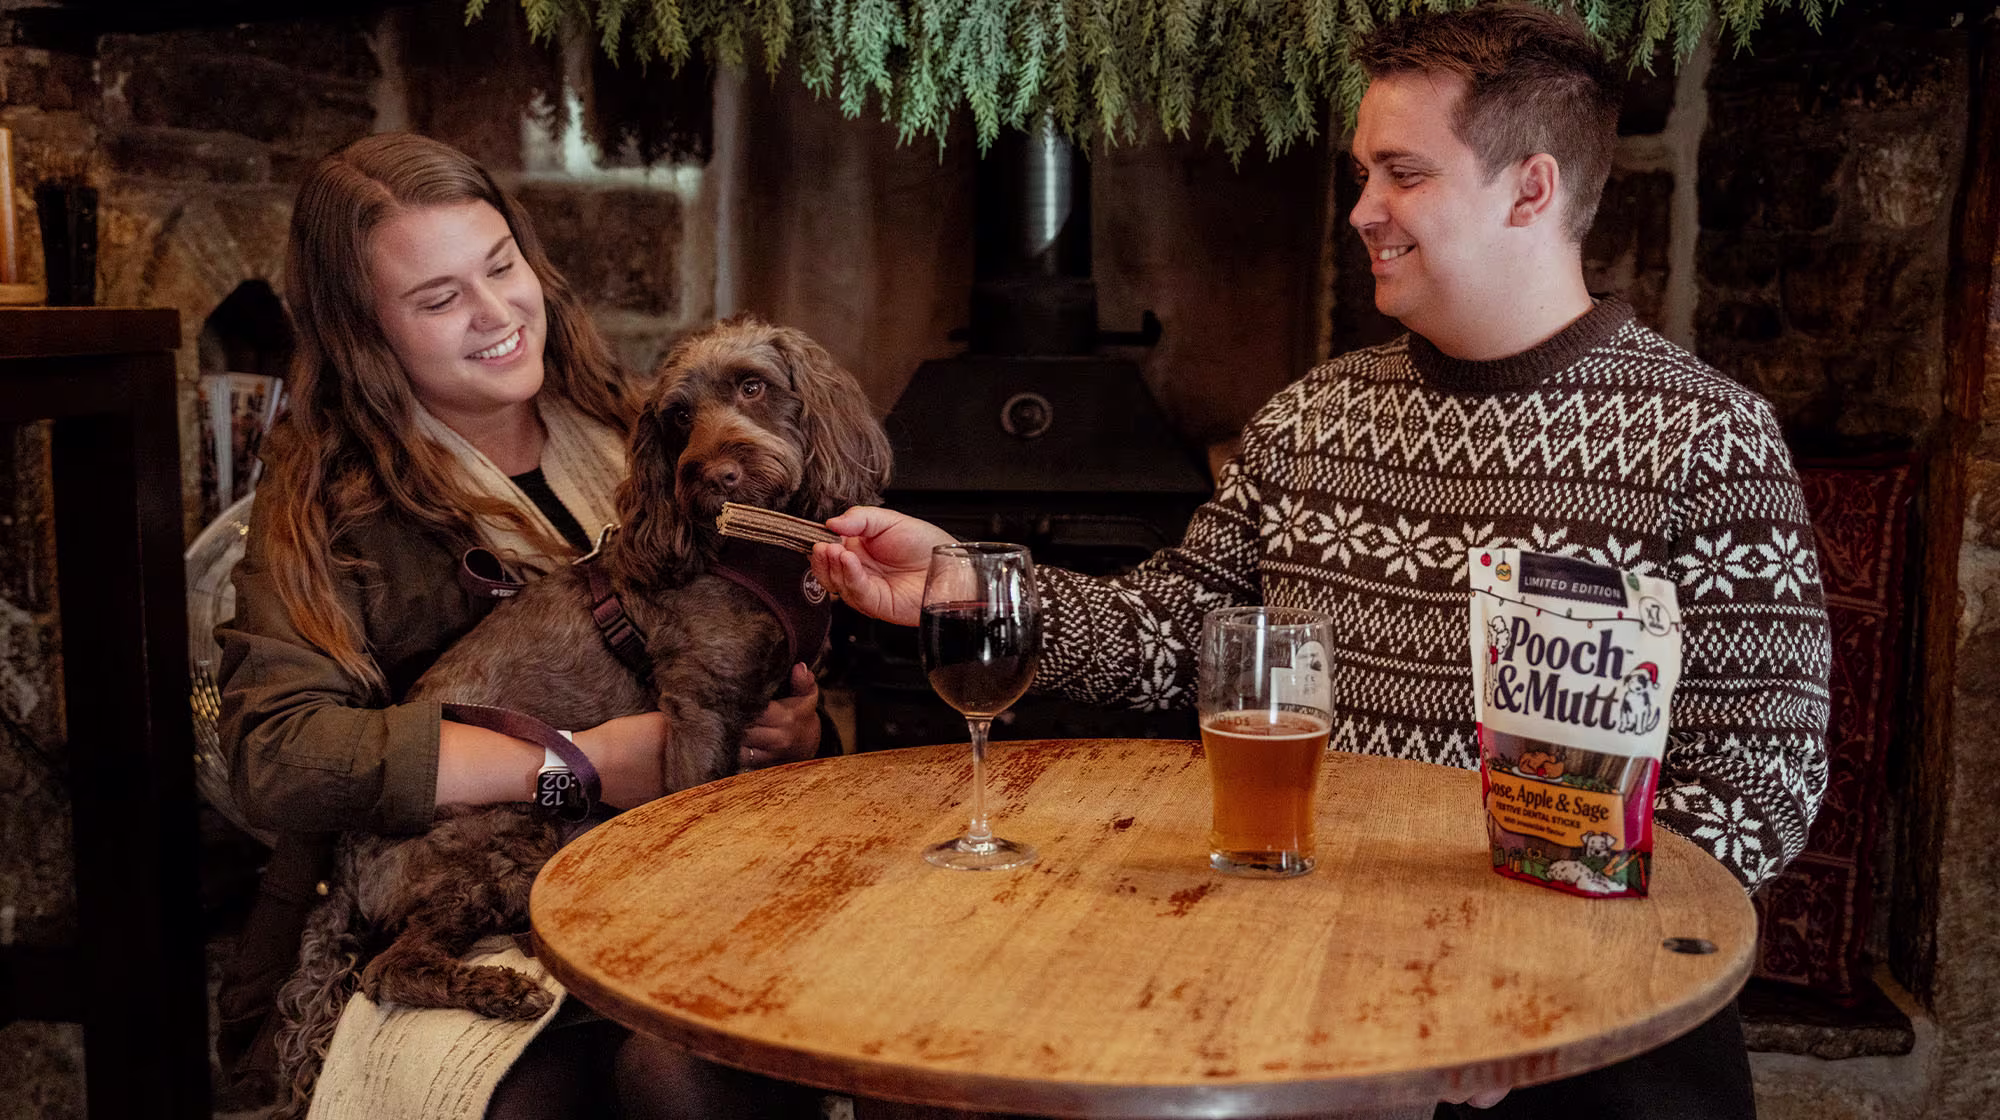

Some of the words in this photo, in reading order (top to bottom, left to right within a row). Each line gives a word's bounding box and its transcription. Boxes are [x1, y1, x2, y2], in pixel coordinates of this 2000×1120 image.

[1524, 576, 1566, 591] LIMITED
[1571, 582, 1621, 599] EDITION
[1502, 616, 1624, 680] Pooch
[541, 791, 565, 806] 12
[1516, 784, 1553, 809] Apple
[1555, 793, 1570, 813] &
[1572, 796, 1609, 823] Sage
[1523, 809, 1549, 823] DENTAL
[1552, 816, 1581, 829] STICKS
